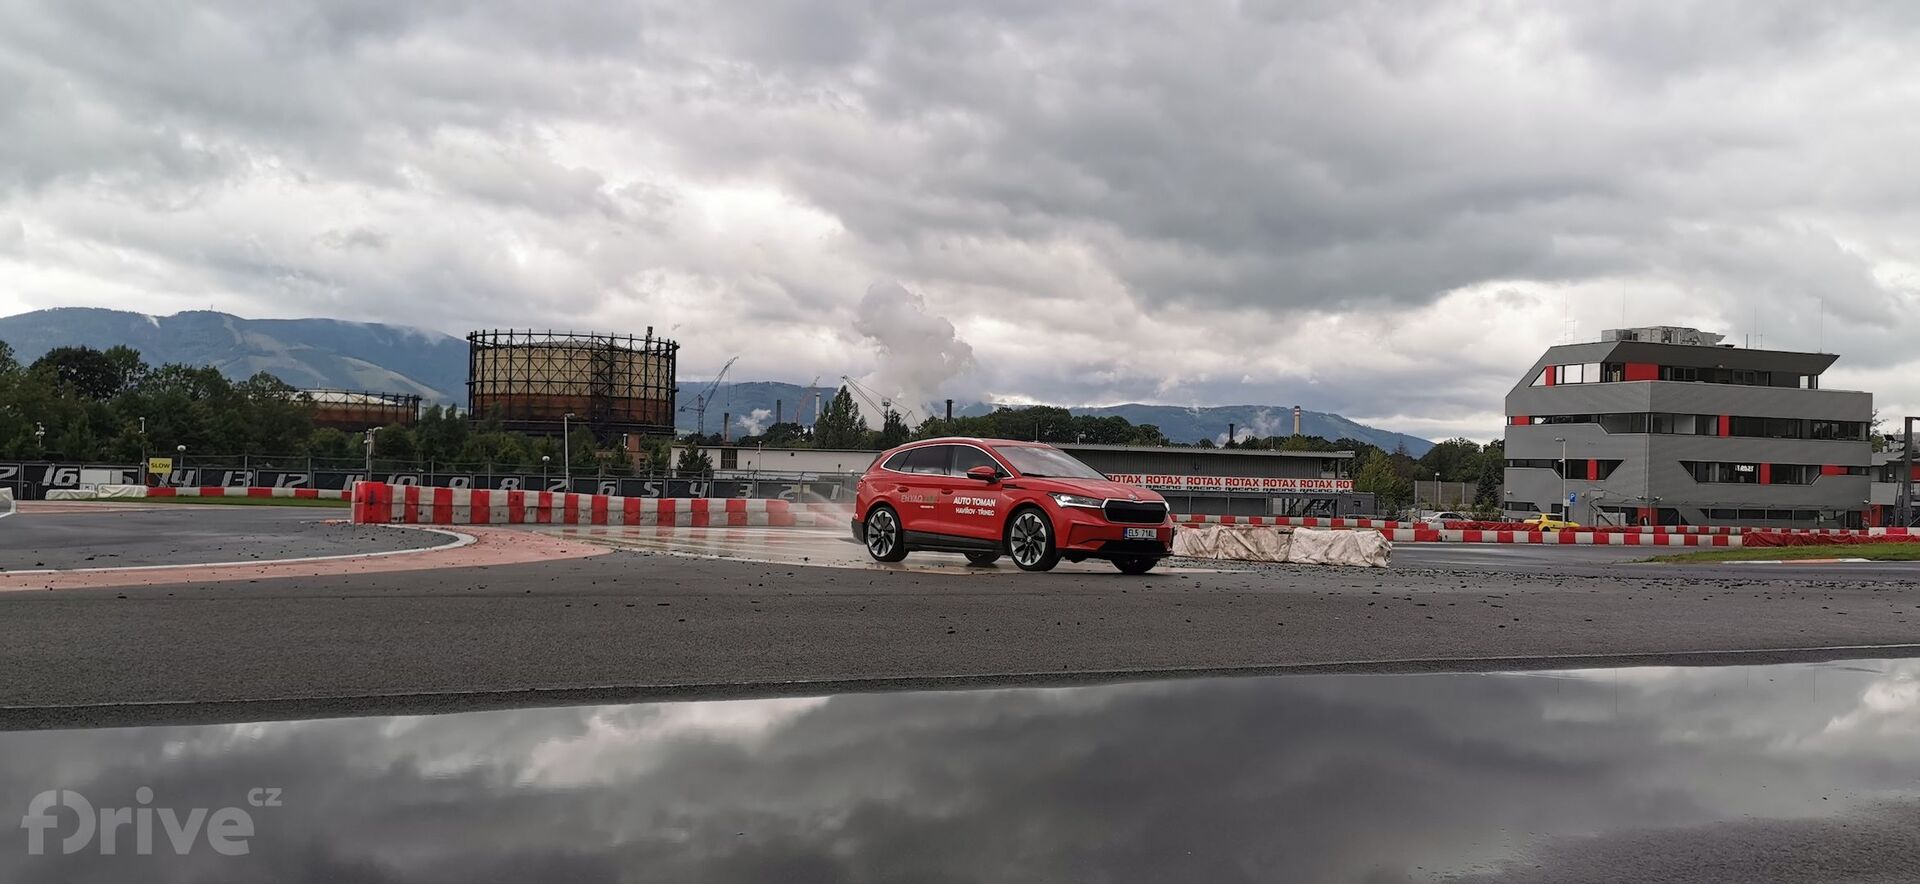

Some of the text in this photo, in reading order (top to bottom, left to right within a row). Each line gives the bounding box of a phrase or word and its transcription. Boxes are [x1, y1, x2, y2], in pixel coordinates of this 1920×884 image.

[42, 465, 79, 486] 16
[221, 470, 254, 488] 13
[275, 473, 308, 488] 12
[1145, 475, 1182, 485] ROTAX
[1186, 476, 1222, 486] ROTAX
[1225, 477, 1260, 487] ROTAX
[1263, 479, 1297, 488] ROTAX
[1300, 480, 1333, 489] ROTAX
[598, 480, 618, 496] 6
[641, 481, 663, 498] 5
[688, 481, 709, 498] 4
[953, 497, 996, 506] AUTO TOMAN
